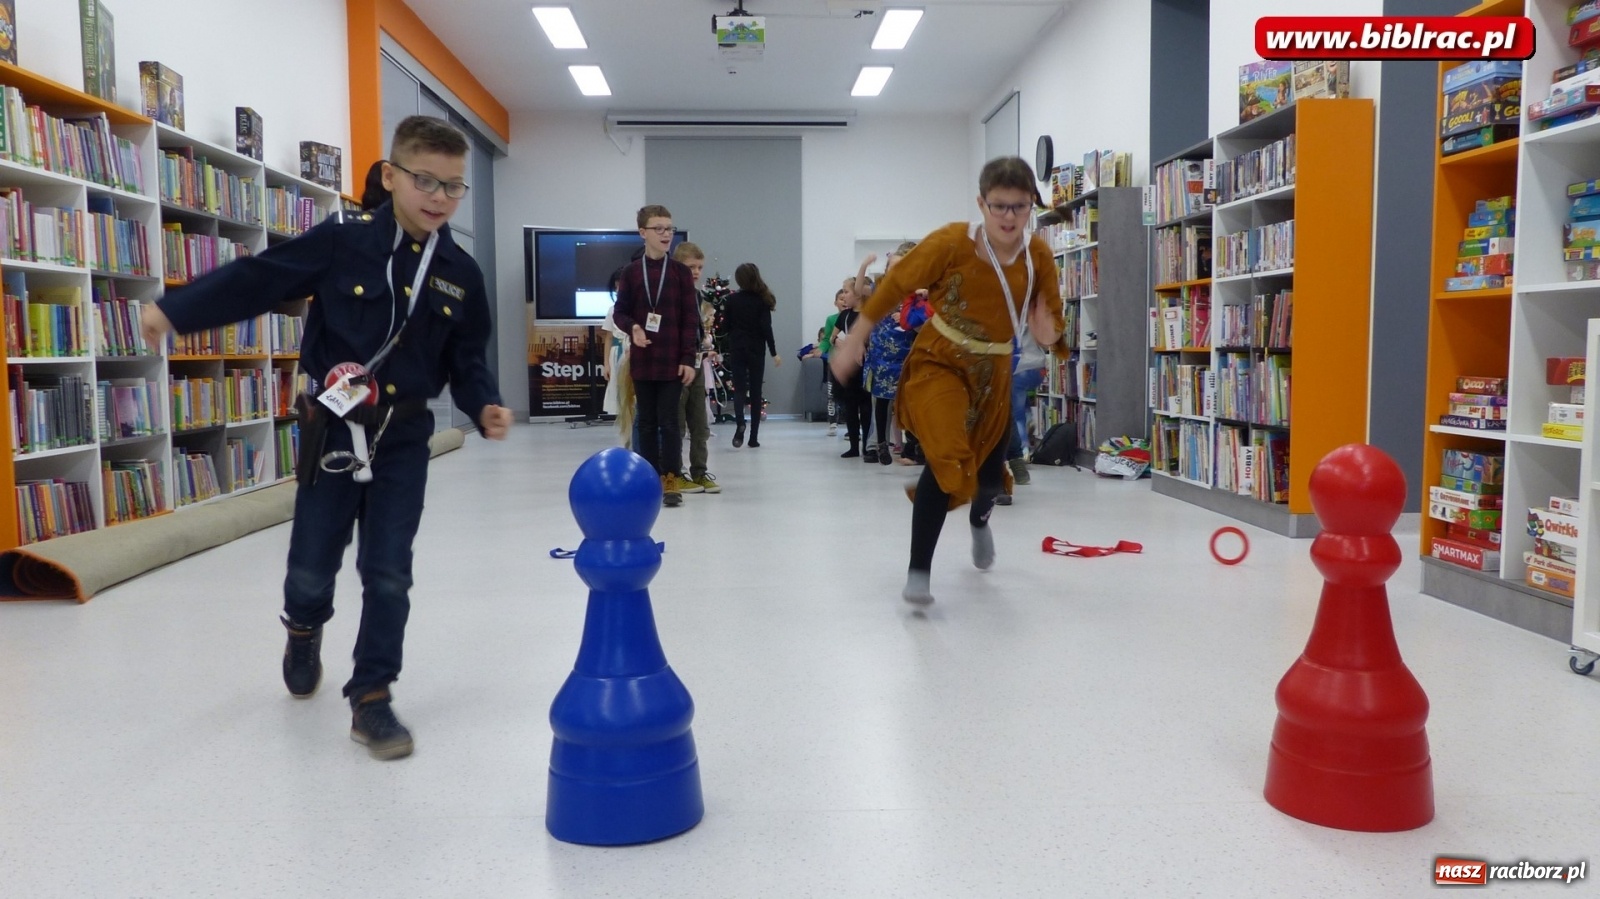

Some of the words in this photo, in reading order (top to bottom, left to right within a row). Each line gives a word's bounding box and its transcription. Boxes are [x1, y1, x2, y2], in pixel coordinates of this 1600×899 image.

[541, 361, 585, 381] Step
[1245, 449, 1253, 479] HOBBY
[1545, 518, 1578, 538] Qwirkle
[1433, 543, 1480, 564] SMARTMAX
